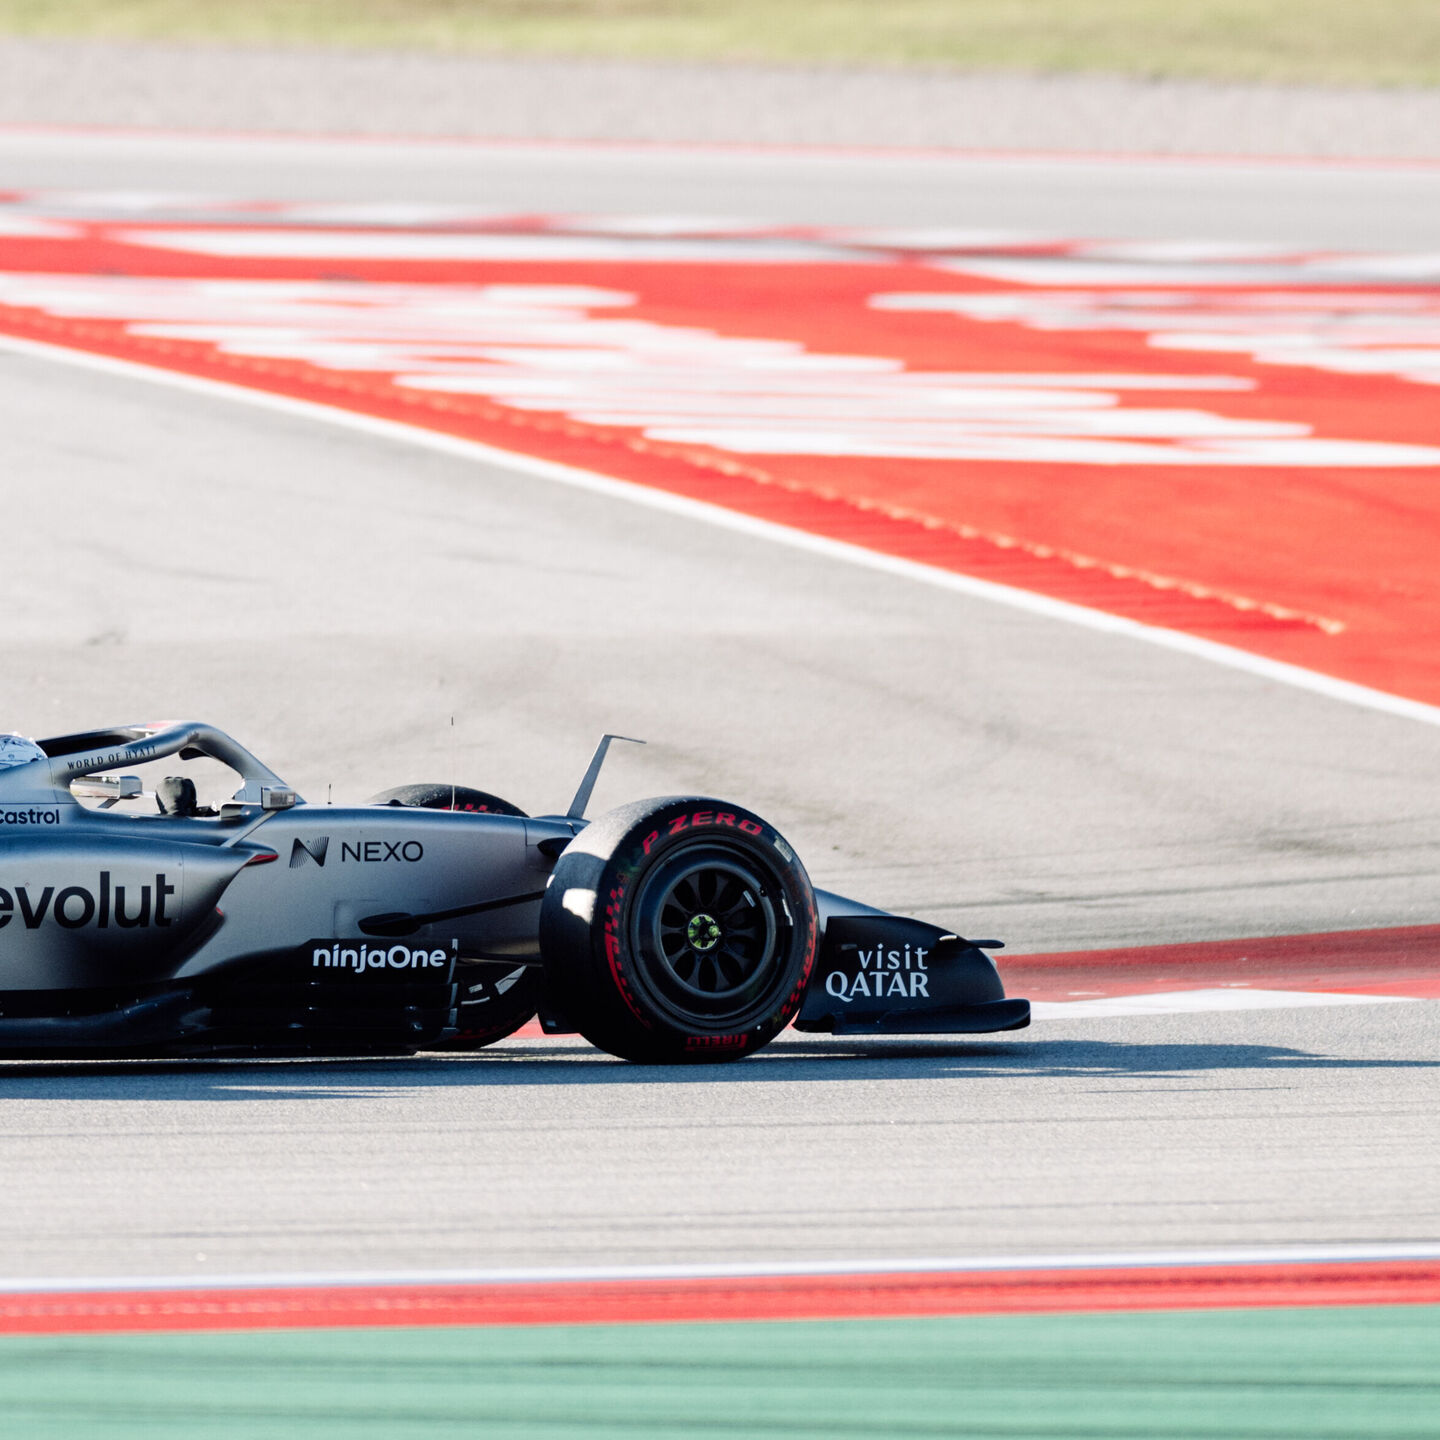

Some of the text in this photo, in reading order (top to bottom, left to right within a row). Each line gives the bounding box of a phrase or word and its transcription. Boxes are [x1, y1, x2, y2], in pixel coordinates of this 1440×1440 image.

[67, 745, 157, 771] WORLD OF HYATT
[641, 810, 763, 855] P ZERO
[341, 840, 424, 862] NEXO
[312, 943, 447, 974] ninjaOne
[858, 943, 929, 970] visit
[825, 971, 930, 1003] QATAR
